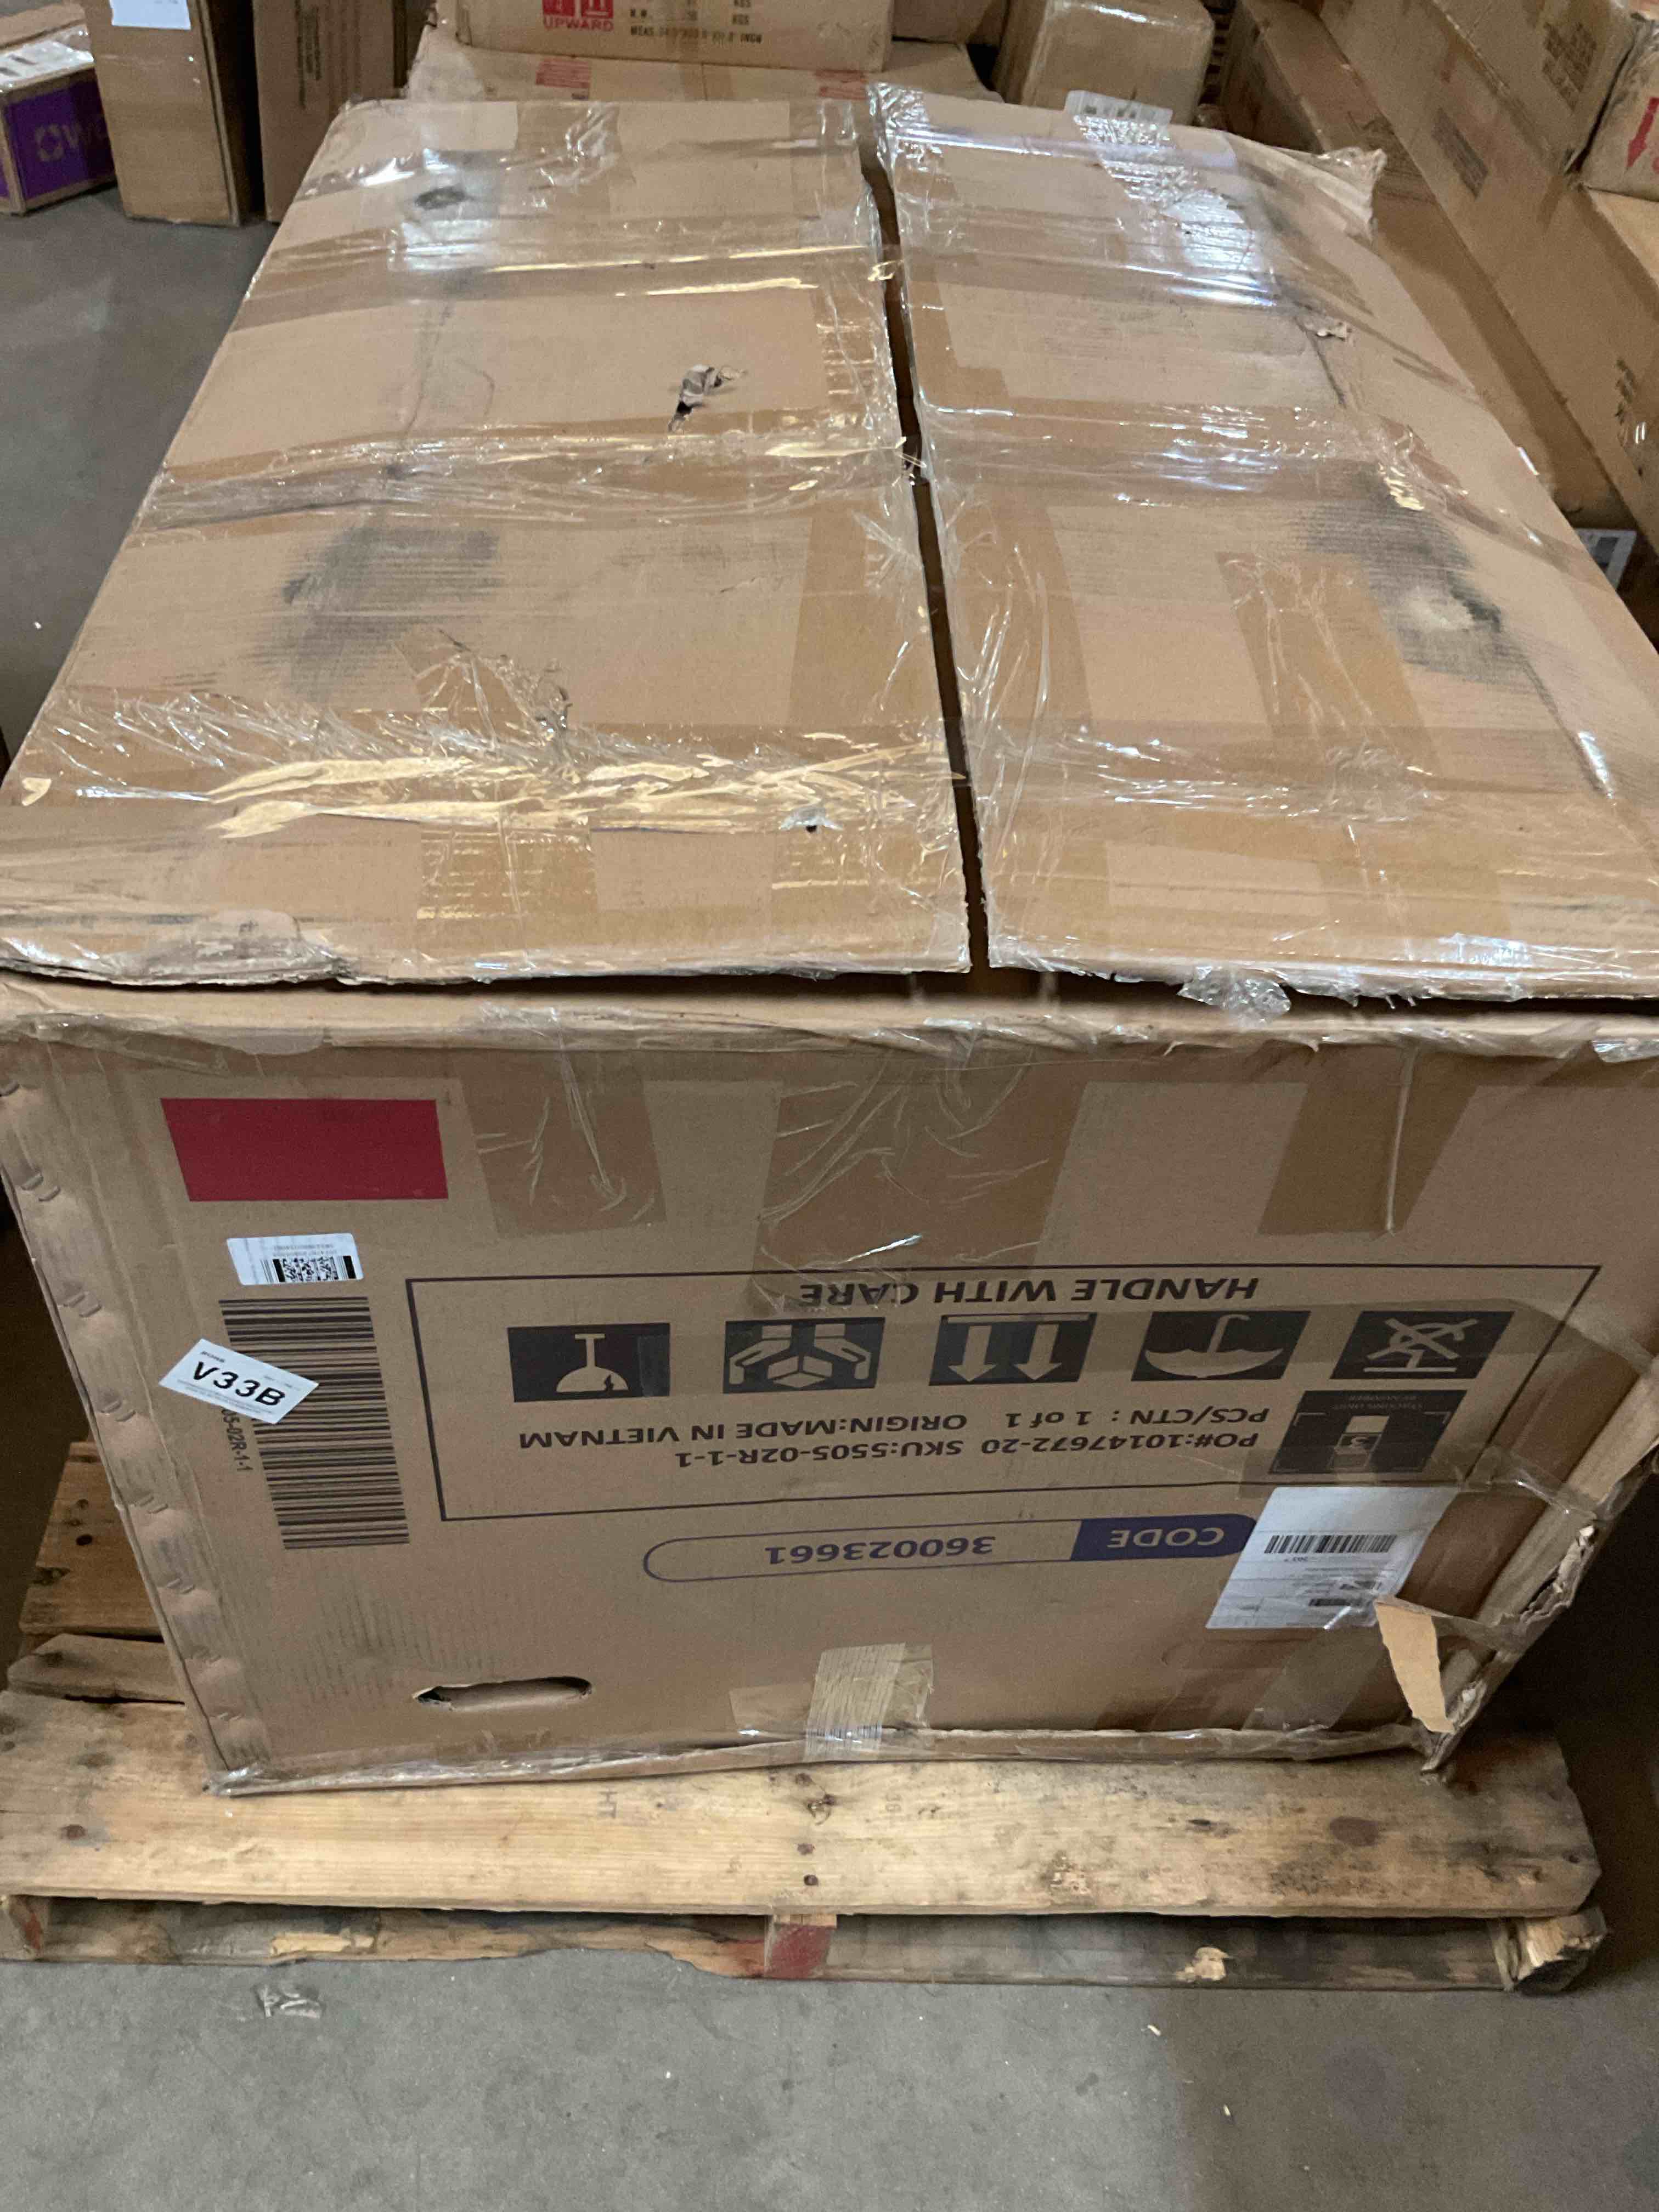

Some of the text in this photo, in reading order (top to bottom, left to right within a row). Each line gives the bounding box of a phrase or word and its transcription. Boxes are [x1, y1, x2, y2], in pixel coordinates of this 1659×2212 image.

[542, 16, 614, 31] UPWARD
[799, 1278, 1259, 1305] HANDLE WITH CARE
[194, 1362, 285, 1406] V33B
[1006, 1413, 1021, 1427] 1
[1030, 1412, 1064, 1428] of
[1076, 1412, 1091, 1426] 1
[1130, 1406, 1269, 1425] PCS/CTN
[692, 1424, 724, 1440] IN
[736, 1415, 967, 1438] ORIGIN:MADE
[520, 1427, 680, 1448] VIETNAM
[675, 1432, 1259, 1467] PO#:10147672-20 SKU:5505-02R-1-1
[1108, 1527, 1224, 1548] CODE
[765, 1536, 995, 1564] 360023661
